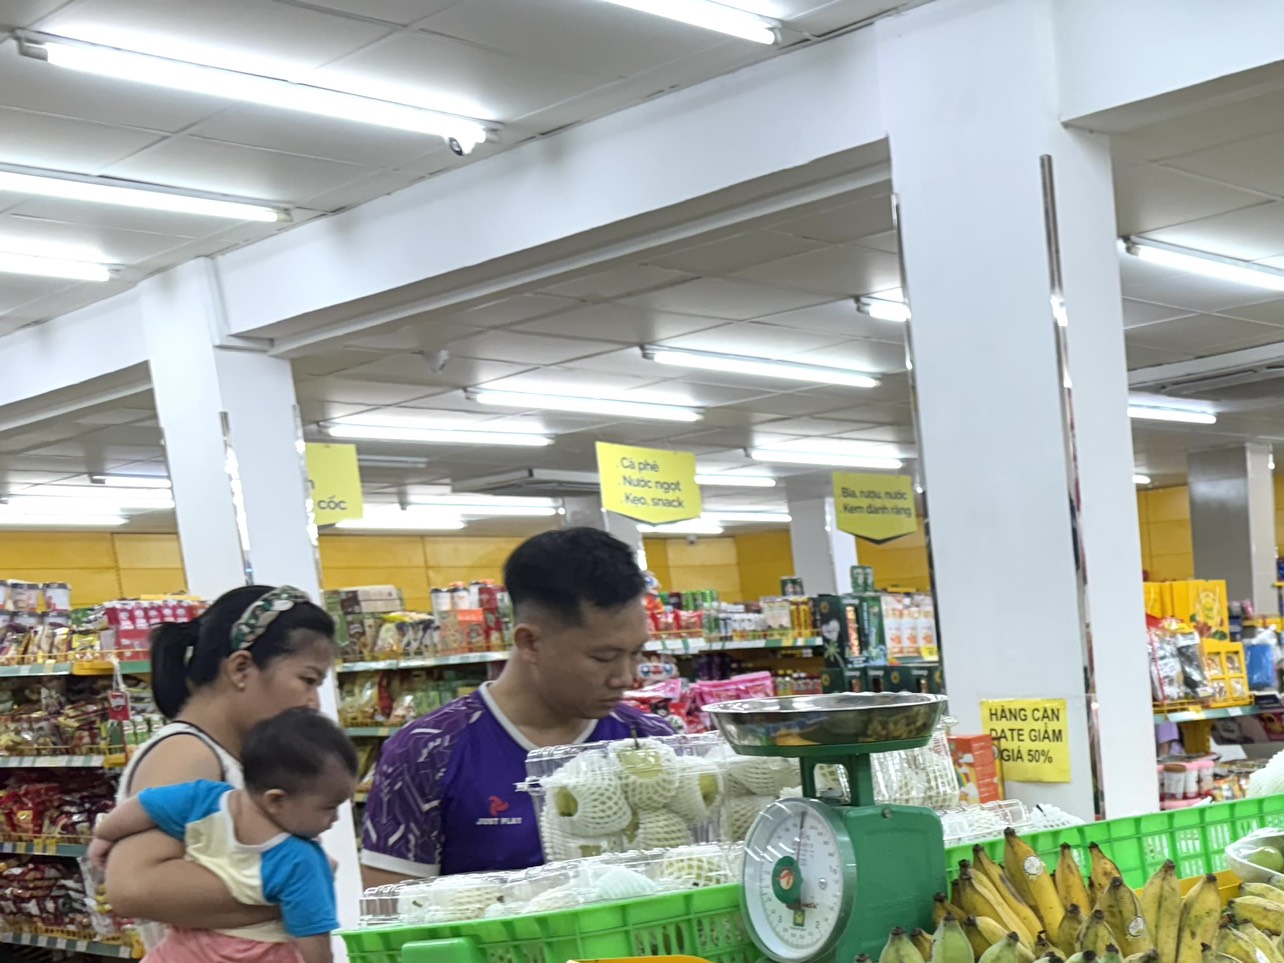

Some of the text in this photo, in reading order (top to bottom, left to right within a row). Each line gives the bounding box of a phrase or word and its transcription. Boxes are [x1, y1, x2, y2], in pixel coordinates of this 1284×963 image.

[317, 495, 347, 510] cốc
[989, 705, 1028, 722] HÀNG
[990, 728, 1025, 742] DATE
[1001, 746, 1053, 763] GIÁ 50%
